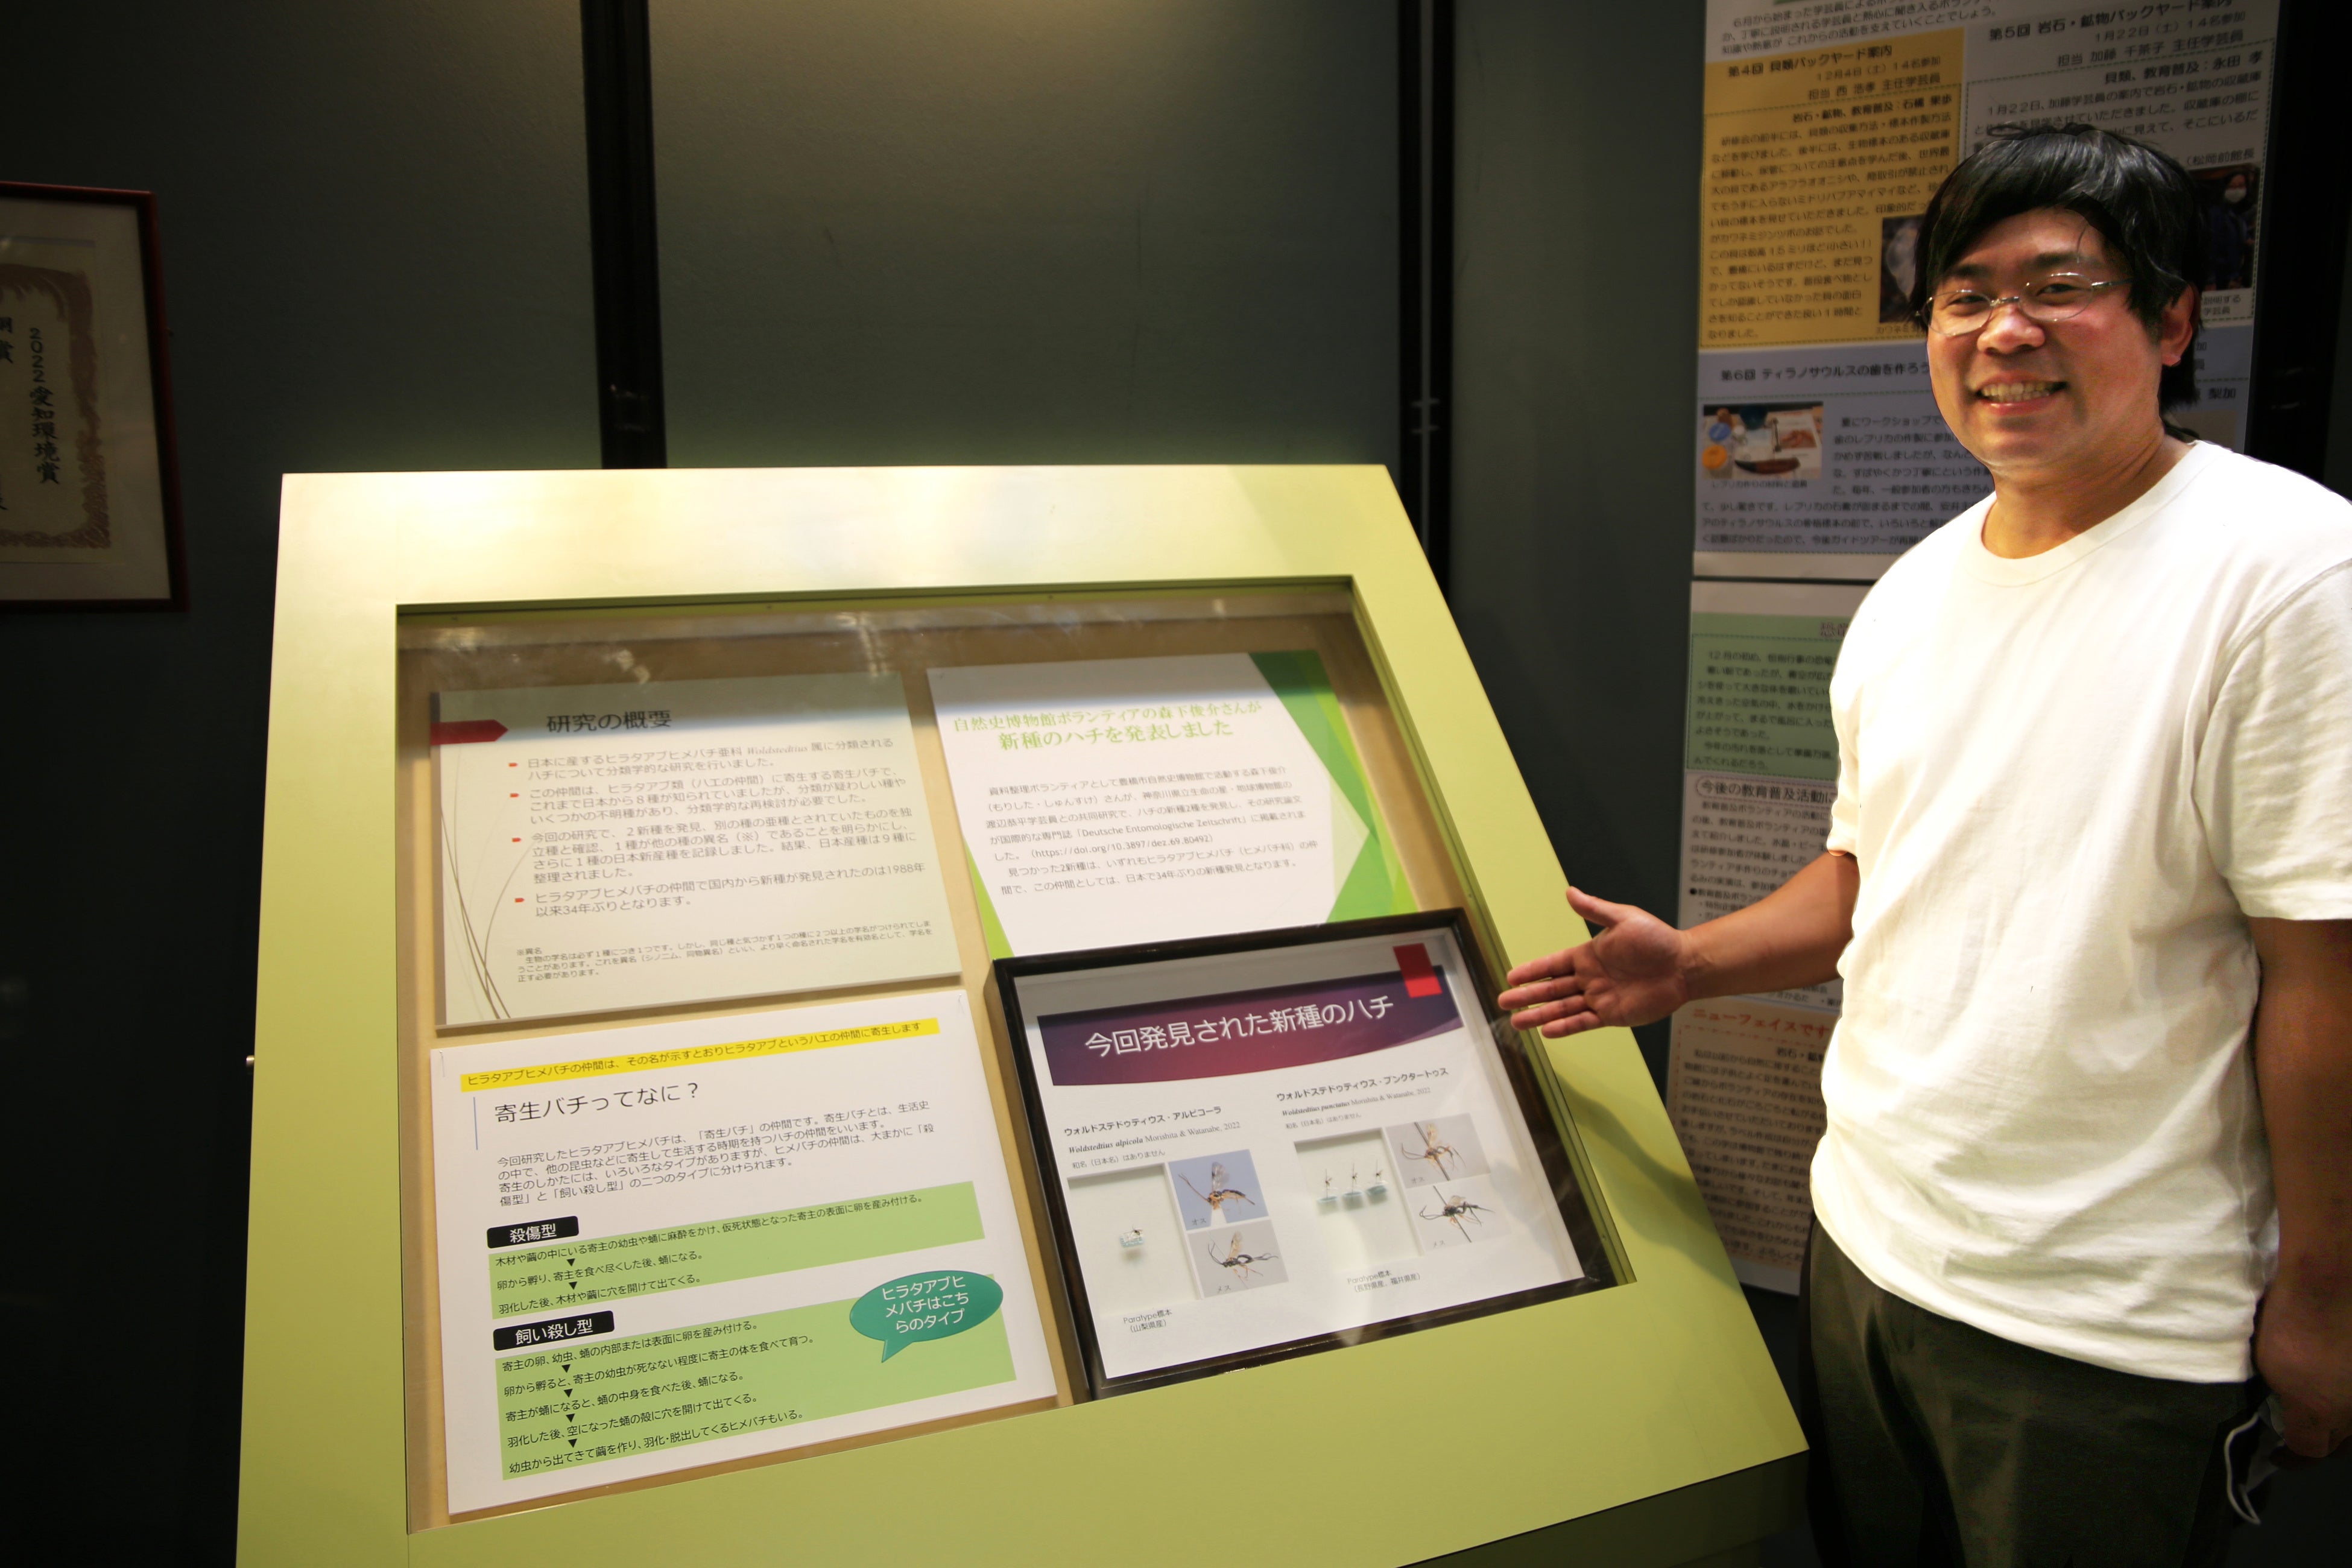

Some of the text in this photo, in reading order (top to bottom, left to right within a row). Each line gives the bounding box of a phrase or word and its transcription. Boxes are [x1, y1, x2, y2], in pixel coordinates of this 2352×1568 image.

[546, 710, 672, 733] 研究の概要
[998, 719, 1234, 751] 新種のハチを発表しました
[1085, 994, 1394, 1058] 今回発見された新種のハチ
[494, 1082, 699, 1124] 寄生バチってなに？
[1069, 1142, 1113, 1154] Woldstedtius
[1116, 1137, 1143, 1148] alpicola
[1145, 1130, 1178, 1143] Morishita
[1224, 1121, 1241, 1131] 2022
[510, 1222, 557, 1244] 殺傷型
[497, 1250, 703, 1291] 卵から孵り、寄主を食べ尽くした後、蛹になる。
[499, 1273, 701, 1314] 羽化した後、木材や繭に穴を開けて出てくる。
[882, 1274, 966, 1301] ヒラタアブヒ
[885, 1292, 969, 1319] メバチはこち
[896, 1306, 966, 1334] らのタイプ
[502, 1320, 757, 1373] 寄主の卵、幼虫、蛹の内部または表面に卵を産み付ける。
[516, 1318, 593, 1345] 飼い殺し型
[505, 1371, 744, 1423] 寄主が蛹になると、蛹の中身を食べた後、蛹になる。
[507, 1393, 757, 1448] 羽化した後、空になった蛹の殻に穴を開けて出てくる。
